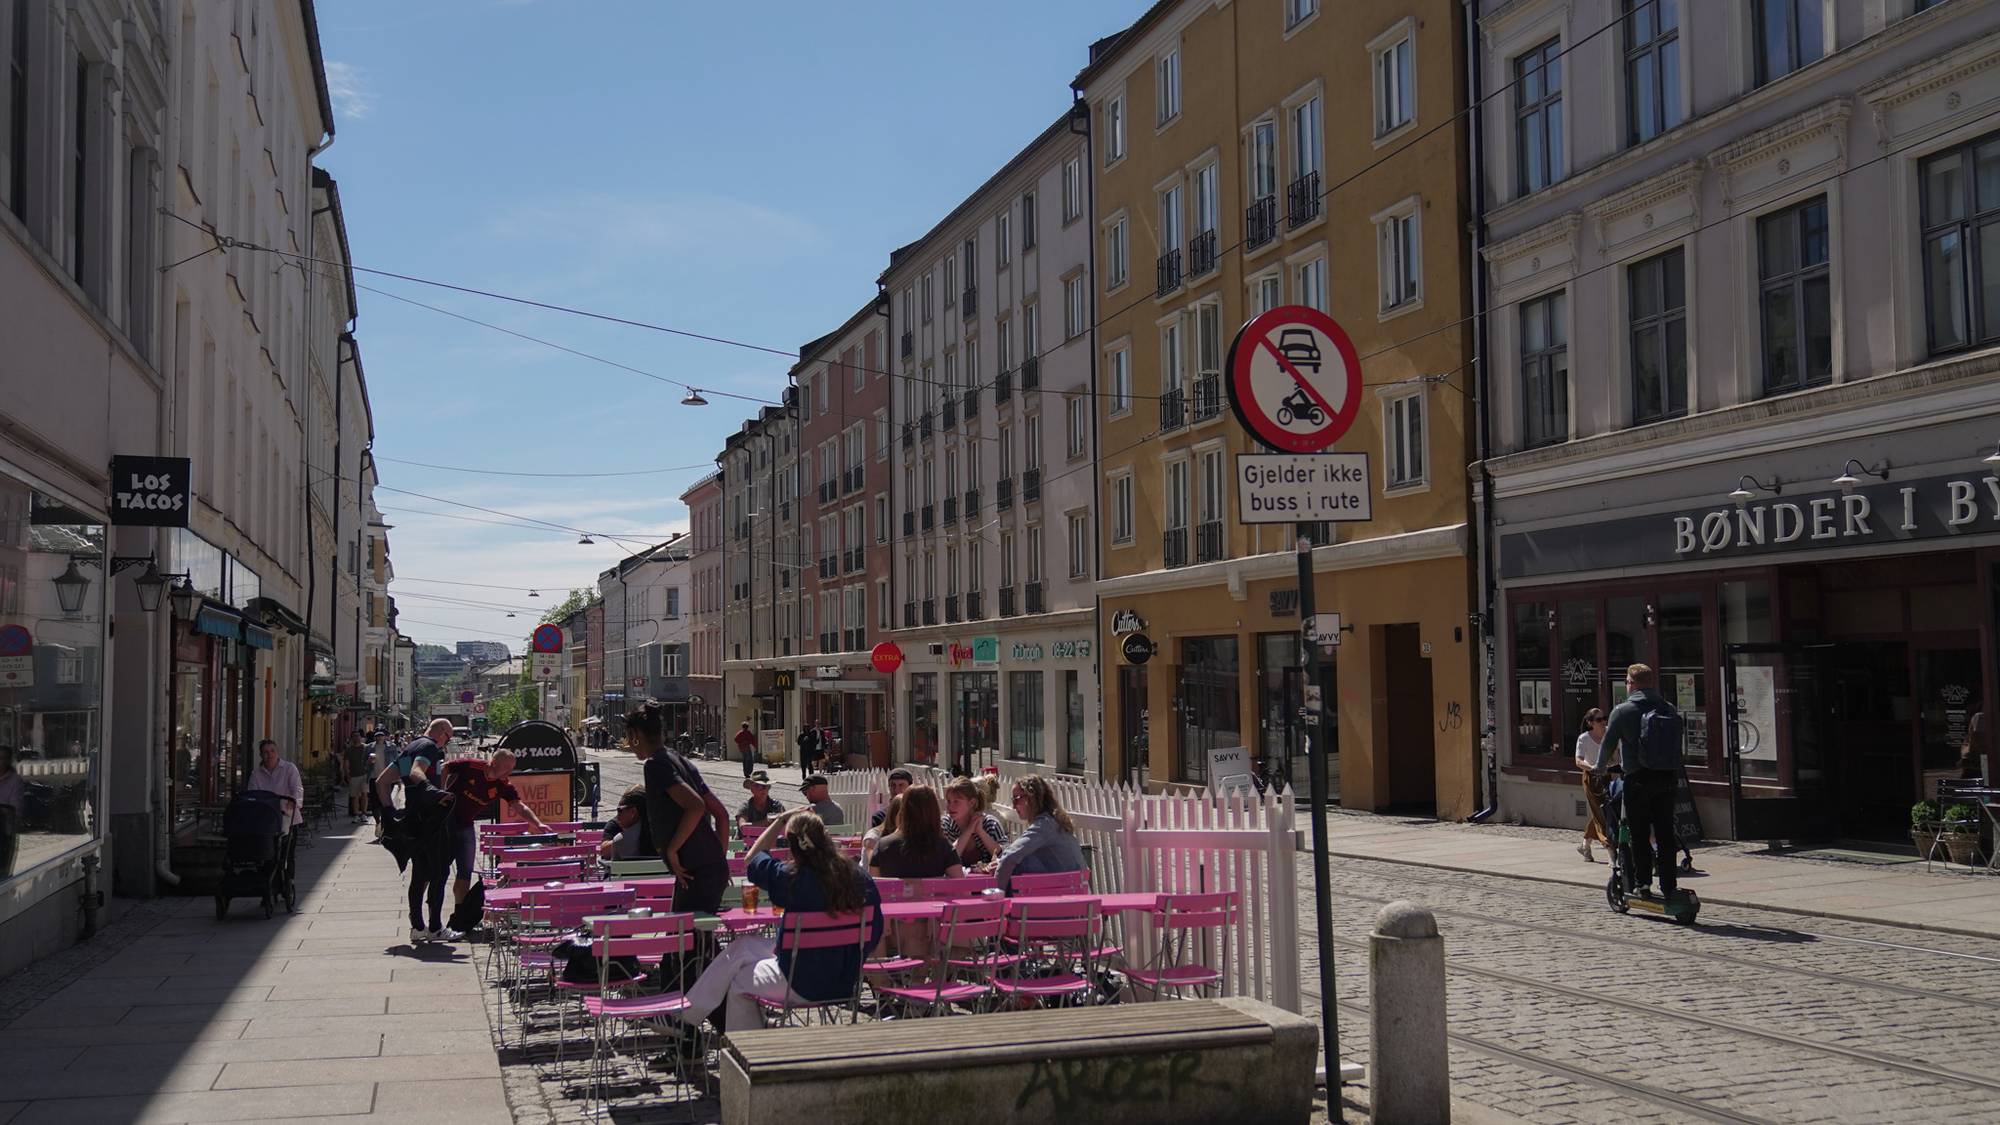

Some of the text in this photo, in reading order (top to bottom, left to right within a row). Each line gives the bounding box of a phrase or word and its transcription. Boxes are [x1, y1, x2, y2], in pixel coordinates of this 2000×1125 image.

[131, 473, 171, 491] LOS
[1245, 464, 1363, 489] Gjelder ikke
[116, 492, 184, 511] TACOS
[1250, 491, 1360, 511] buss i rute
[1673, 494, 1875, 553] BØNDER
[1899, 487, 1918, 530] I
[874, 654, 900, 662] EXTRA
[529, 746, 562, 757] TACOS
[521, 784, 550, 800] WET
